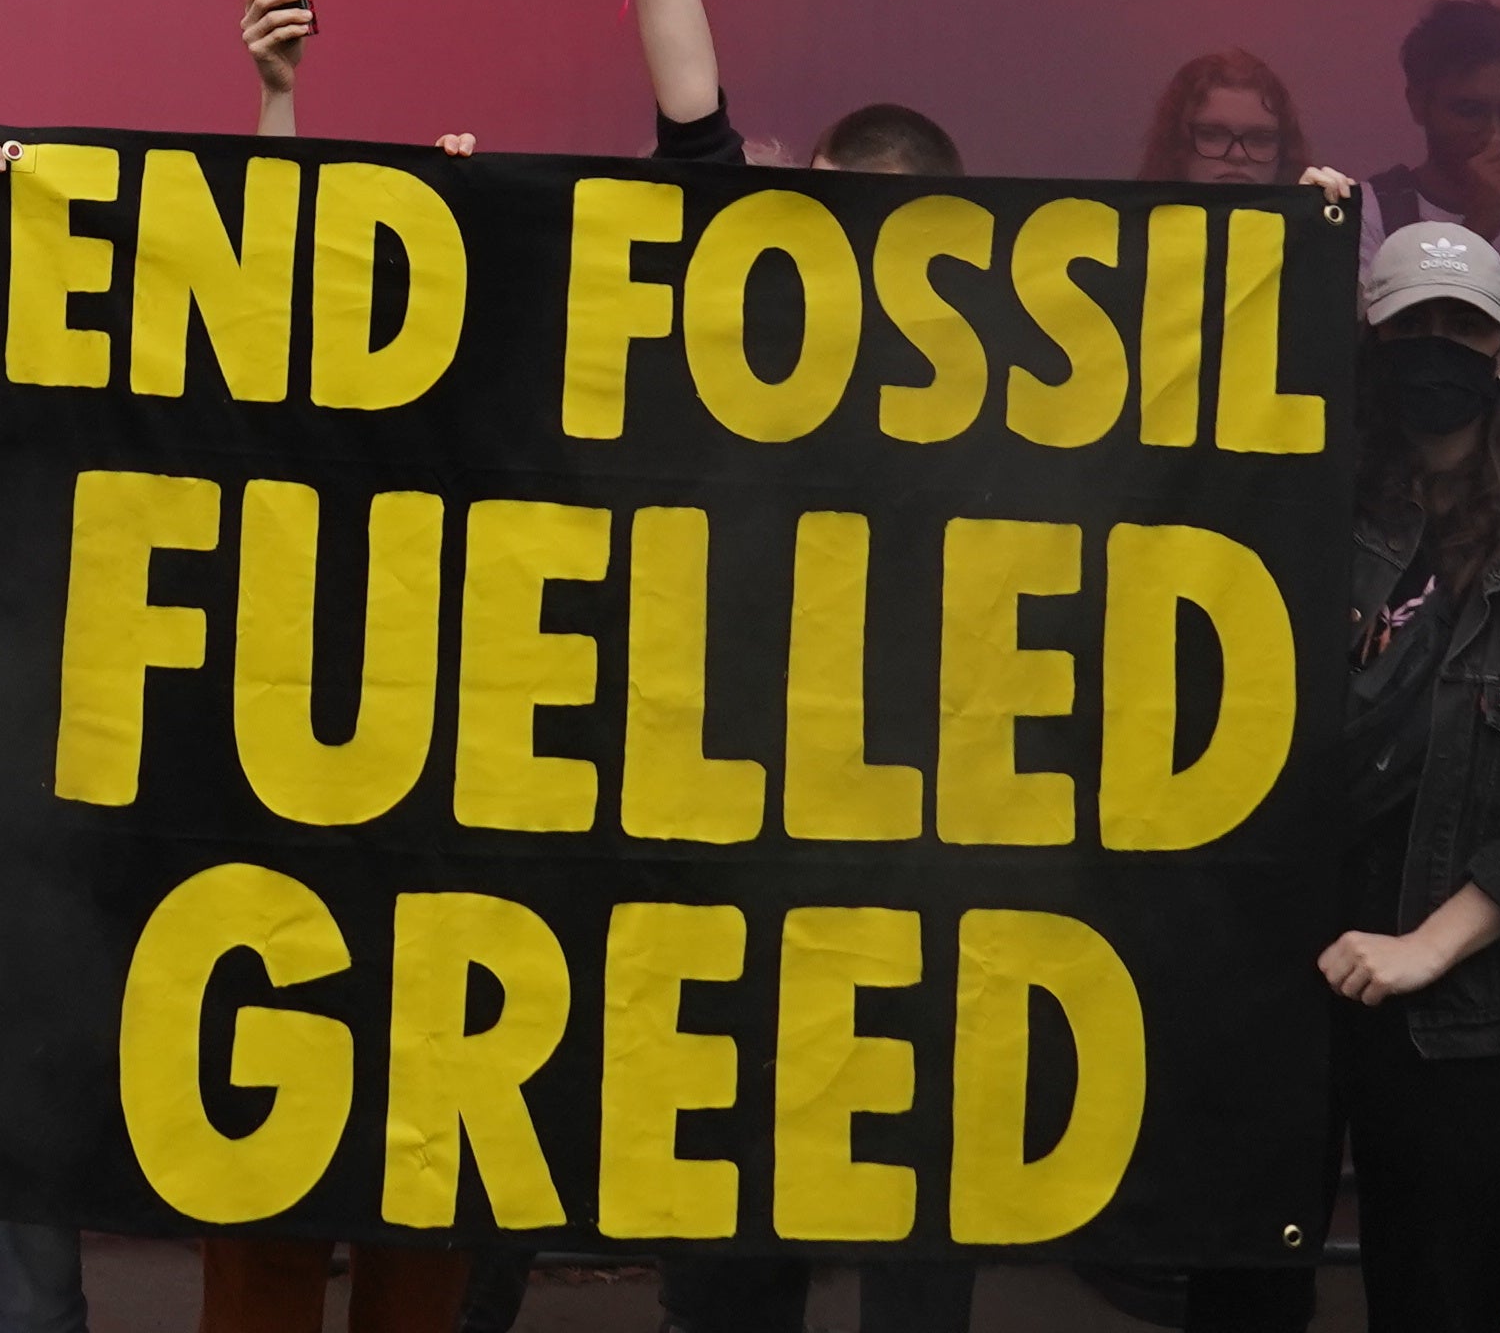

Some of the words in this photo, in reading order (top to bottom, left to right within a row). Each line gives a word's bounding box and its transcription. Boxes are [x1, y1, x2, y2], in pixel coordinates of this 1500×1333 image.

[5, 144, 469, 412] END
[562, 177, 1327, 455] FOSSIL
[1419, 259, 1469, 272] adidas
[54, 470, 1298, 852] FUELLED
[119, 862, 1148, 1246] GREED
